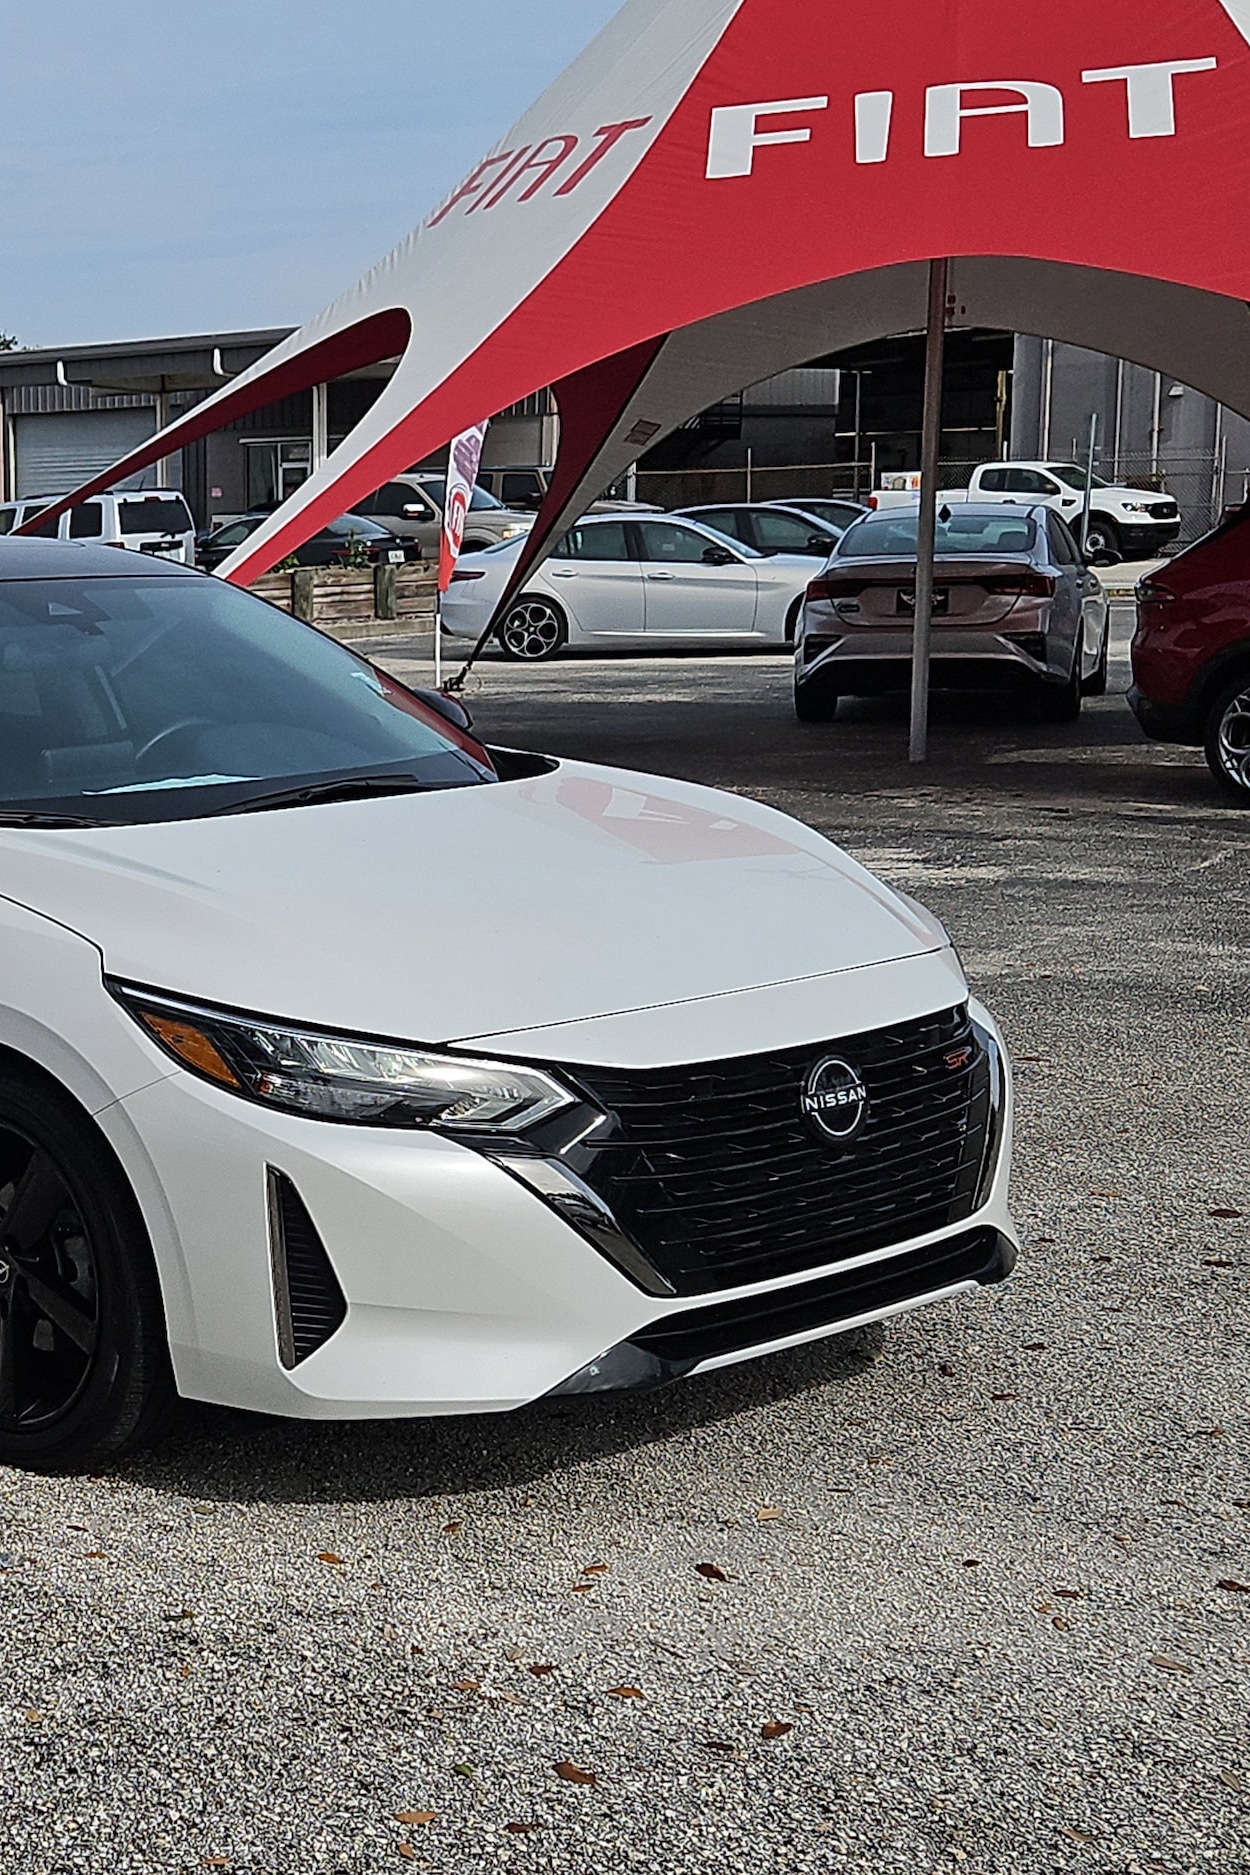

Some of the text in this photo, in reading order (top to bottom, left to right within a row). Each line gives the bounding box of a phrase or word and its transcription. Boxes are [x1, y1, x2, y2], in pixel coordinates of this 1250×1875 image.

[705, 56, 1218, 180] FIAT
[425, 115, 654, 228] FIAT
[943, 1046, 972, 1070] SR
[805, 1085, 867, 1111] NISSAN
